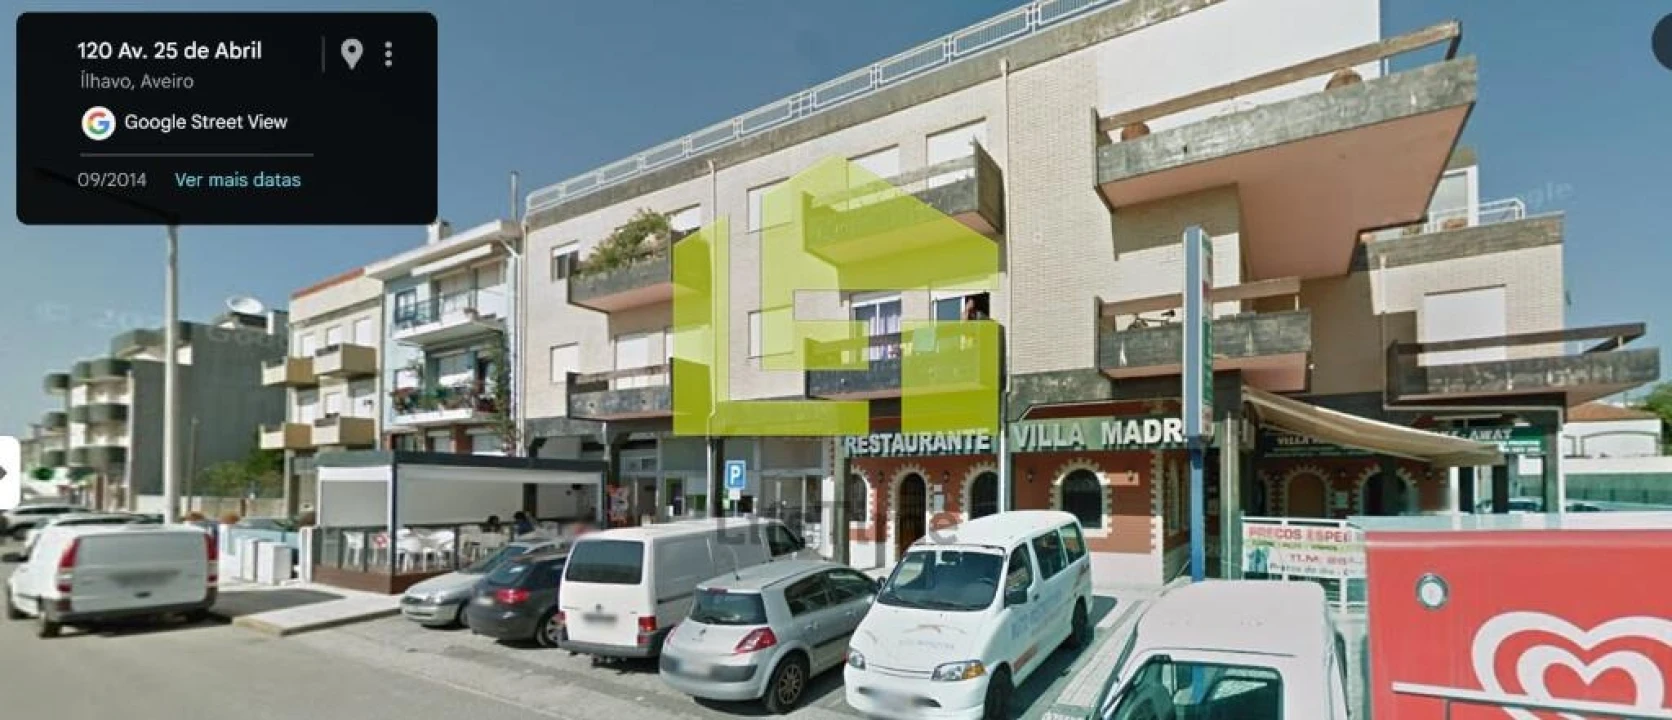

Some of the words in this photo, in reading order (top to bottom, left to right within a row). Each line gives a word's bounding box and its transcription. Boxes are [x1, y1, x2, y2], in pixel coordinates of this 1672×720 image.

[845, 428, 992, 455] RESTAURANTE
[1012, 422, 1085, 448] VILLA
[1101, 417, 1189, 446] MADR
